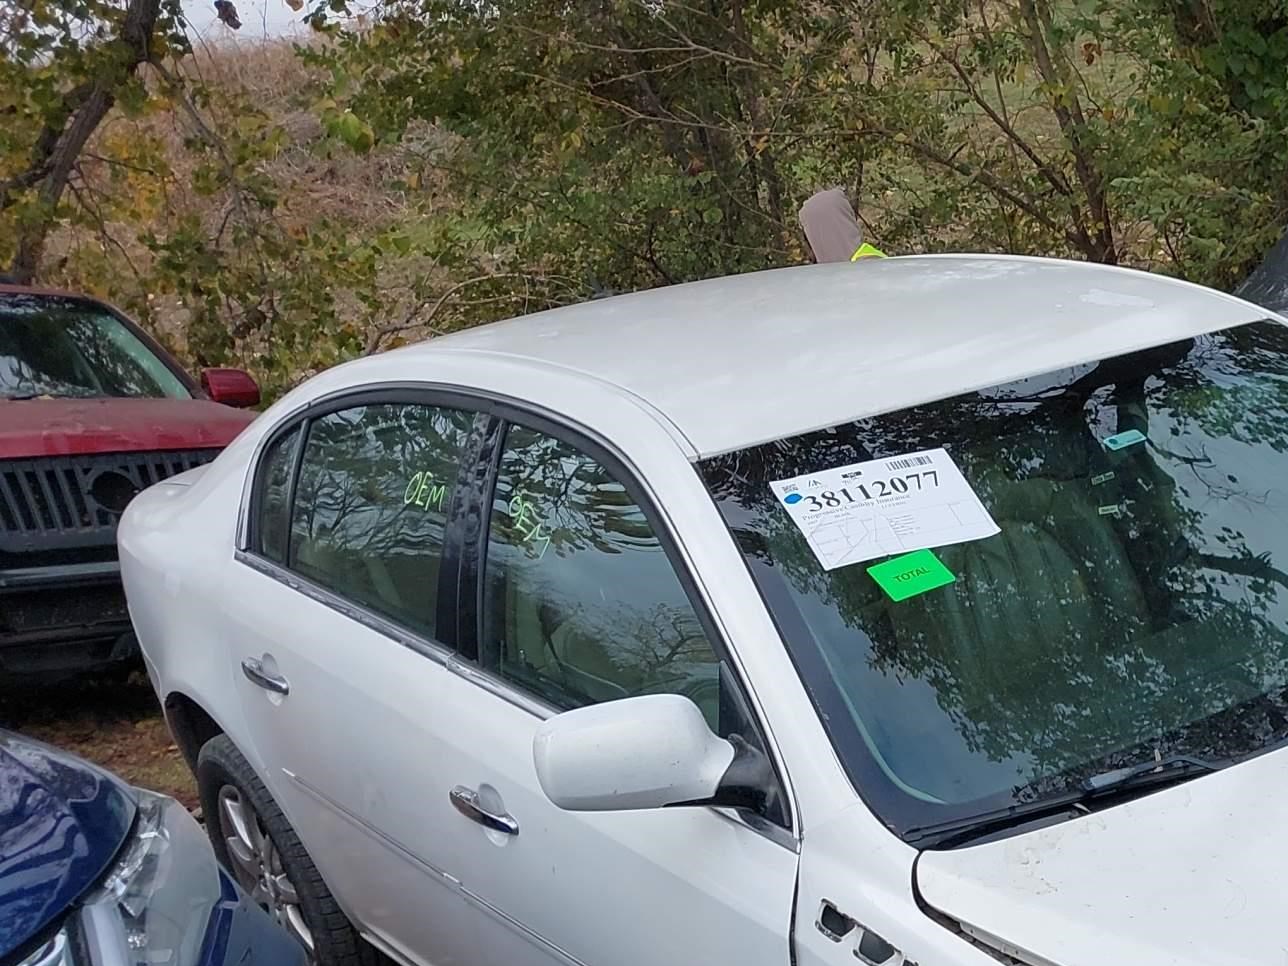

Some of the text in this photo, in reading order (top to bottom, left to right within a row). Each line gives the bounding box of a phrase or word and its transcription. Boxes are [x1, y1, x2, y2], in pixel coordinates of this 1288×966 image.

[404, 471, 446, 512] OEM
[803, 470, 939, 513] 38112077
[508, 495, 551, 560] OEM
[893, 566, 930, 583] TOTAL
